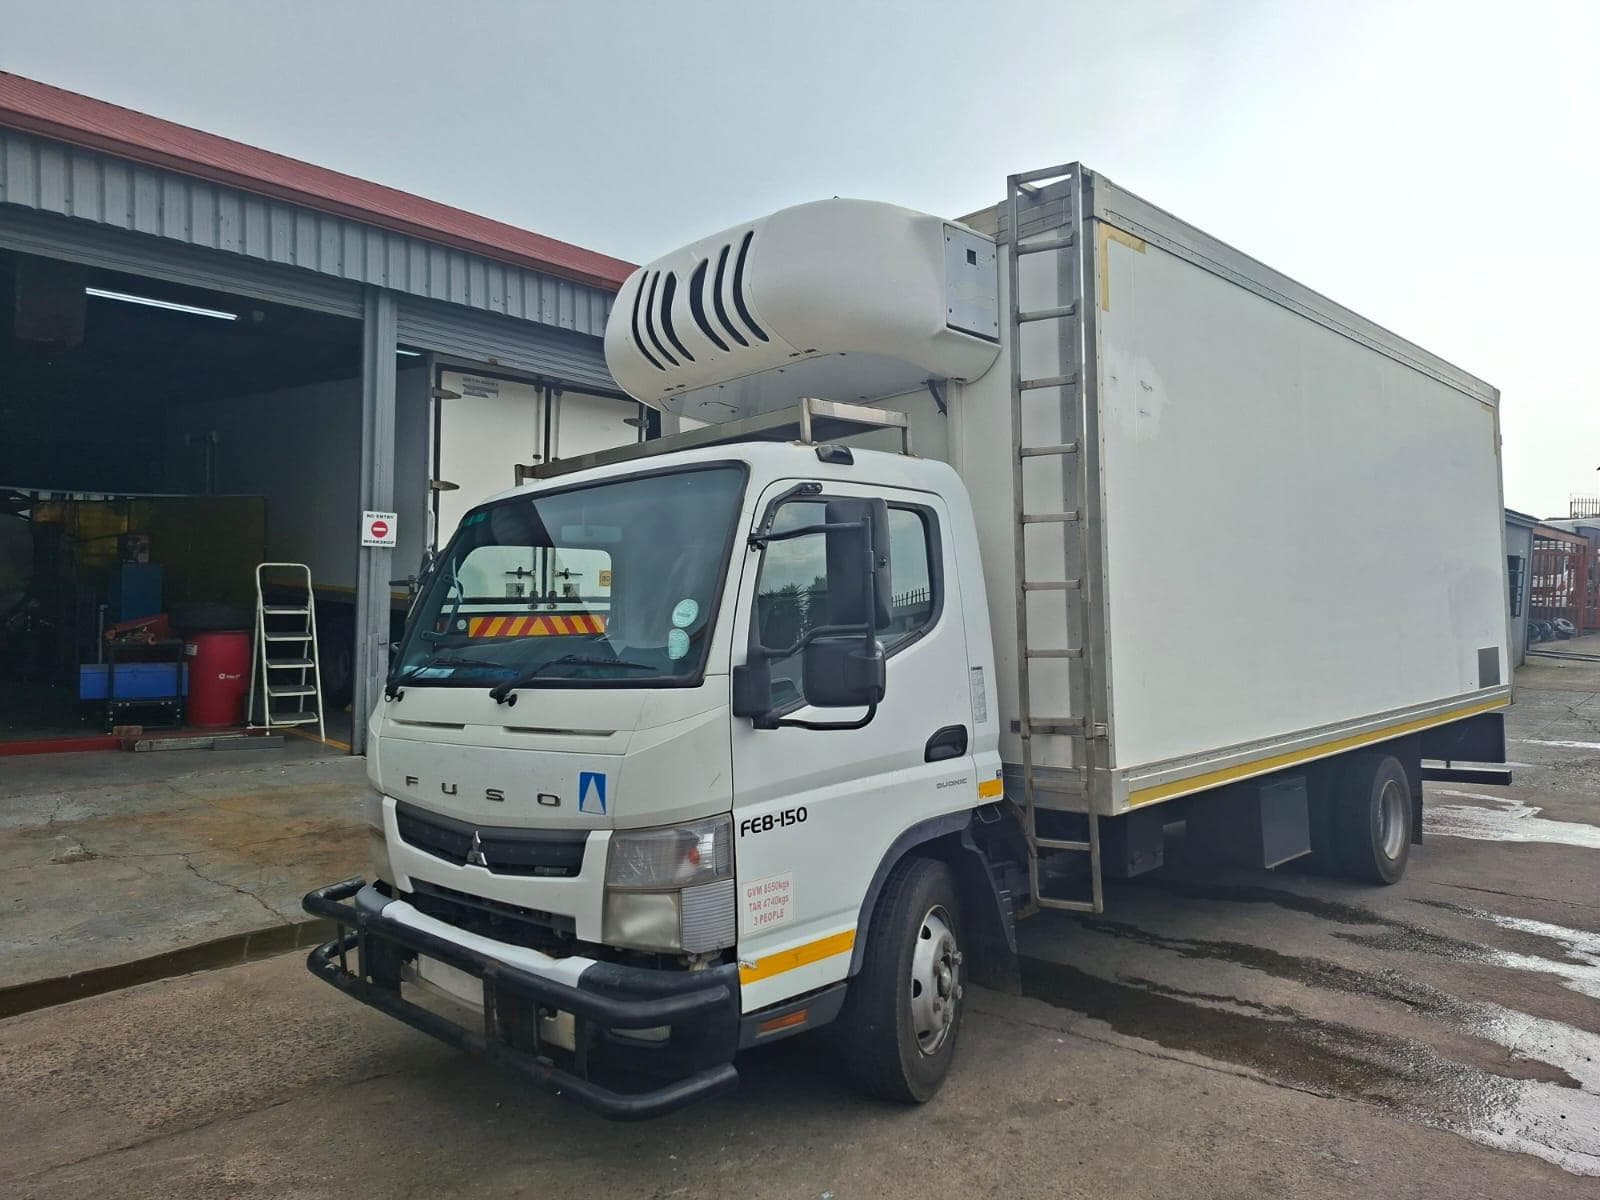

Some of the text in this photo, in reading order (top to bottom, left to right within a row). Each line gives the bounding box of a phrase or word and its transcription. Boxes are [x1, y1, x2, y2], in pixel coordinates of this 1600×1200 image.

[936, 777, 967, 789] DUONIC
[405, 775, 561, 807] FUSO
[740, 806, 808, 837] FEB-150
[747, 885, 763, 898] GVM
[749, 900, 762, 913] TAR
[759, 908, 785, 925] PEOPLE
